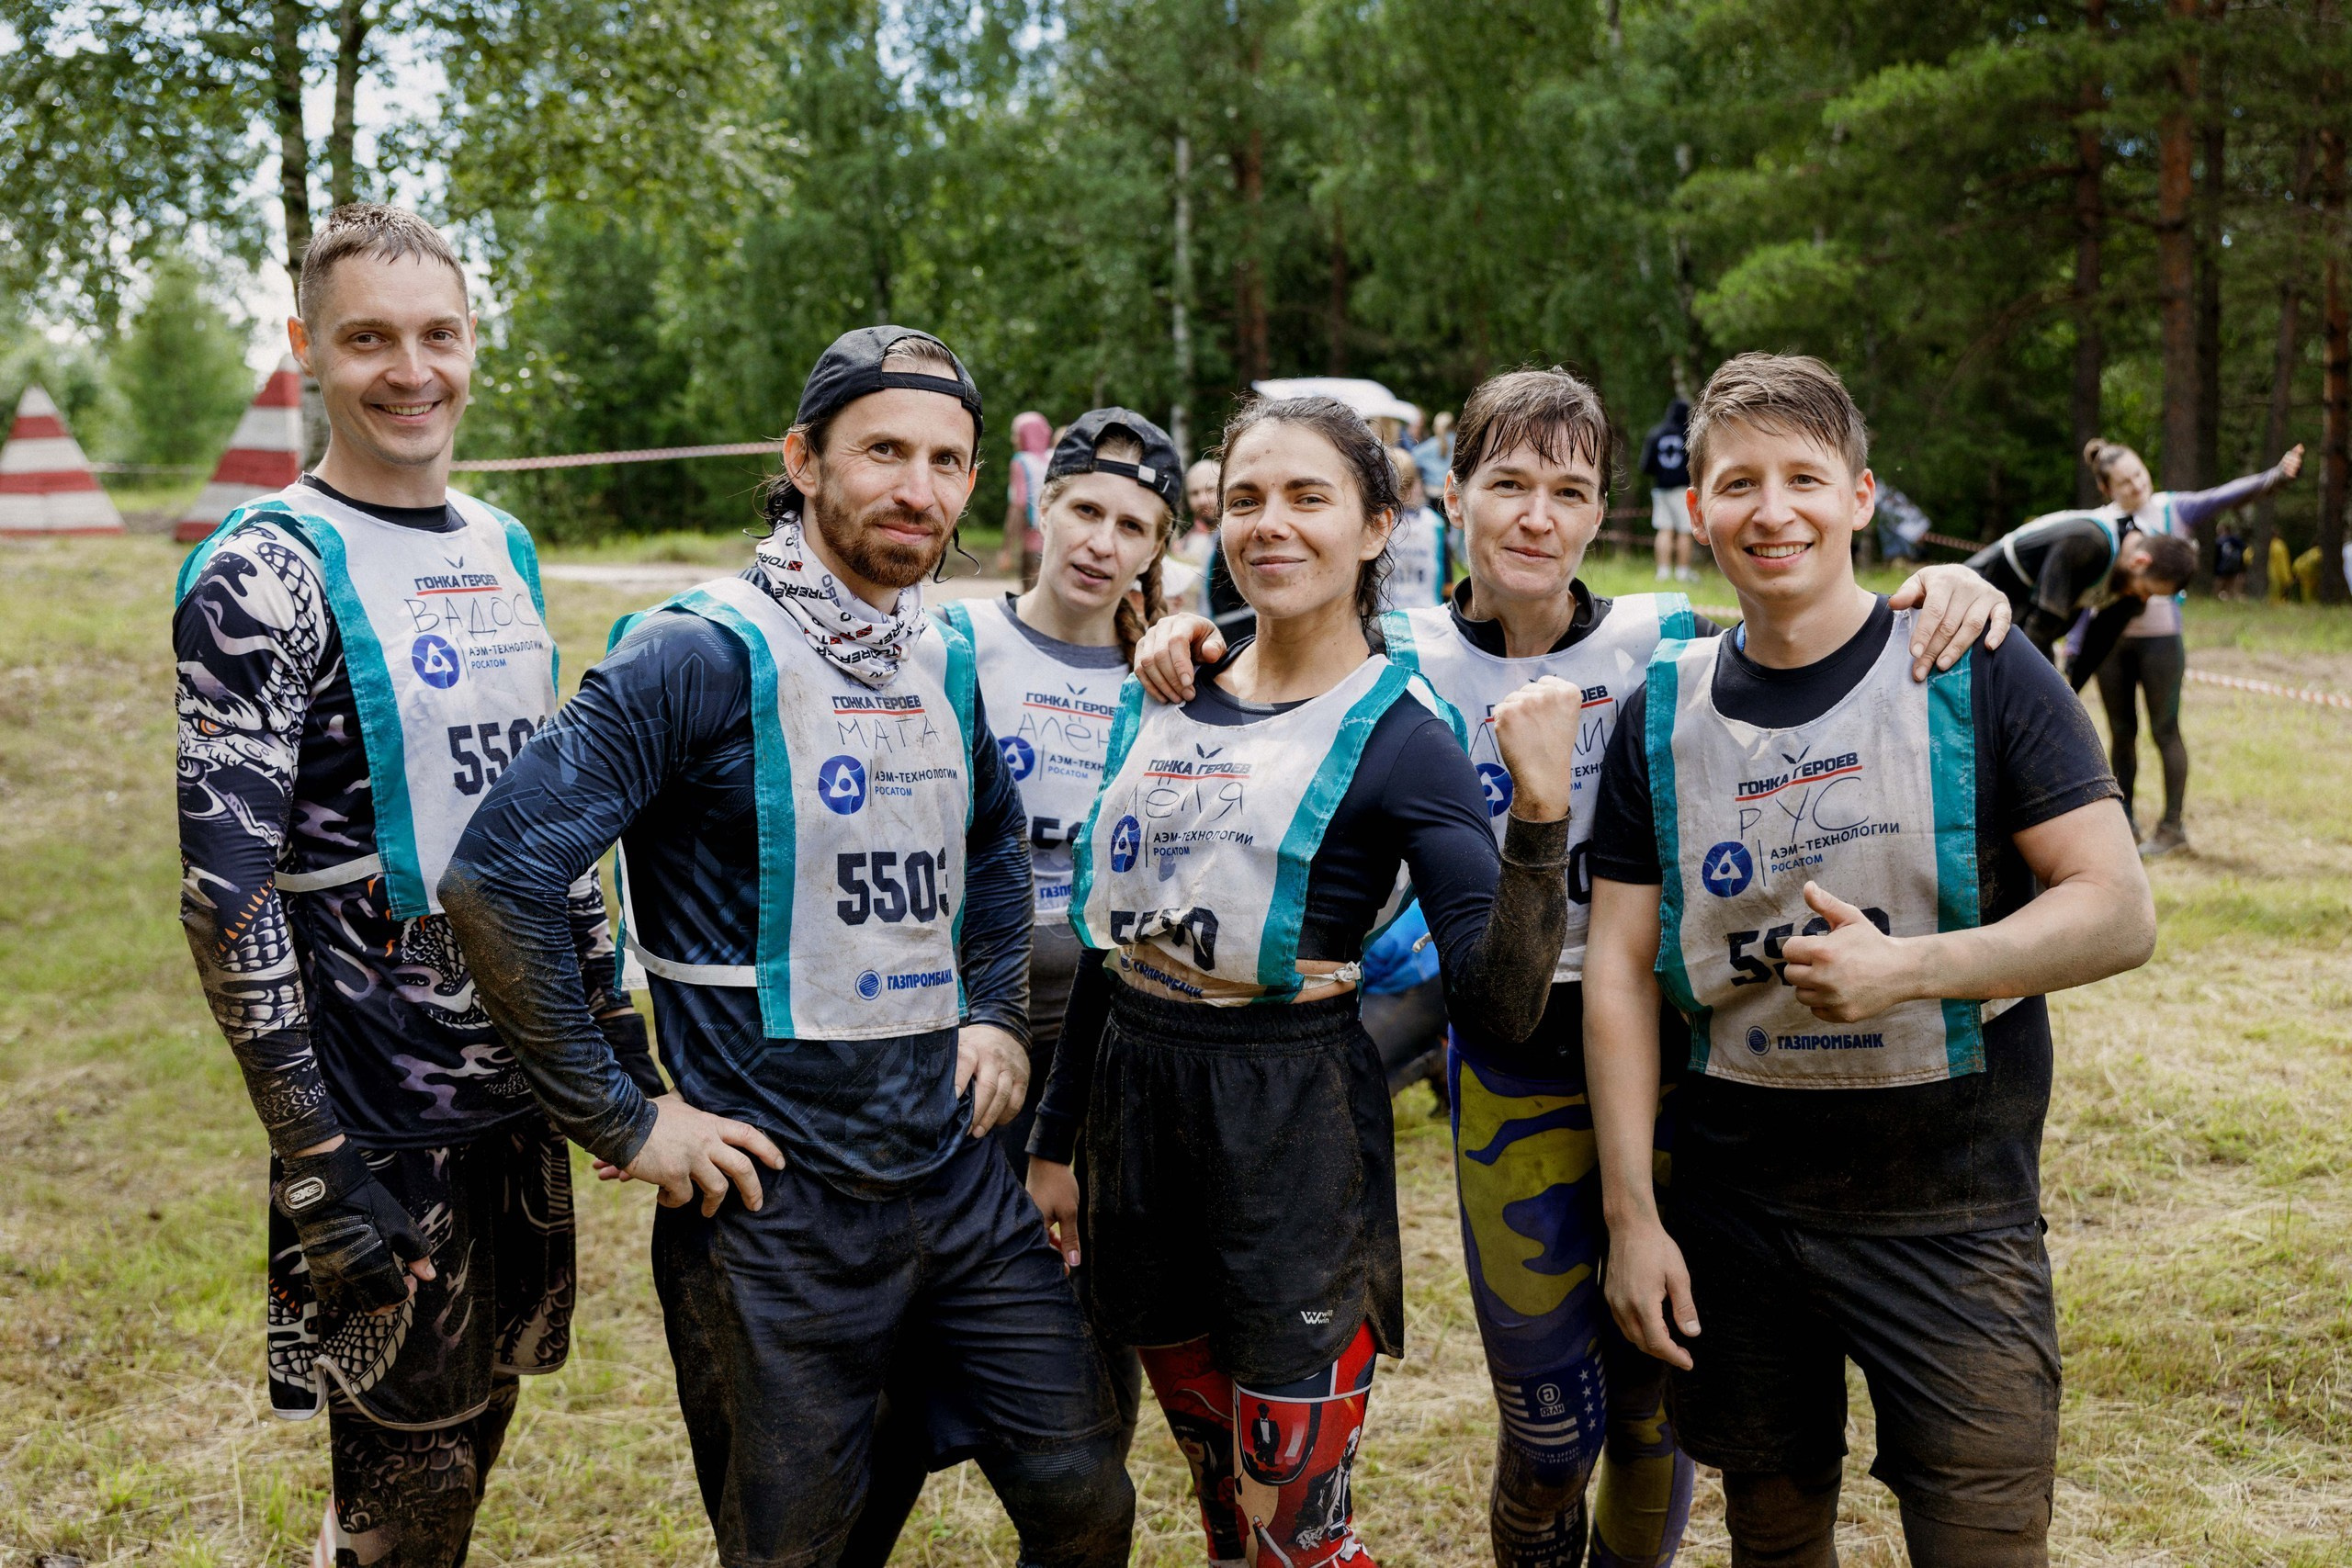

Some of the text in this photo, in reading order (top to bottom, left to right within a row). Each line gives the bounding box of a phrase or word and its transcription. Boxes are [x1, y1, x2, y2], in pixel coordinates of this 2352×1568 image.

[414, 574, 499, 591] ГОНКА ГЕРОЕВ
[404, 593, 539, 641] ВАДОС
[469, 640, 544, 657] АЭМ-ТЕХНОЛОГИИ
[470, 659, 507, 670] РОСАТОМ
[831, 694, 922, 710] ГОНКА ГЕРОЕВ
[1025, 692, 1115, 716] ГОНКА ГЕРОЕ
[447, 715, 547, 796] 550
[1049, 754, 1104, 773] АЭМ-ТЕХН
[875, 769, 957, 783] АЭМ-ТЕХНОЛОГИИ
[1048, 765, 1089, 779] РОСАТОМ
[1148, 759, 1252, 775] ГОНКА ГЕРОЕВ
[1737, 751, 1859, 796] ГОНКА ГЕРОЕВ
[875, 785, 912, 796] РОСАТОМ
[1739, 776, 1870, 844] РУС
[1153, 830, 1254, 847] АЭМ-ТЕХНОЛОГИИ
[1770, 822, 1901, 861] АЭМ-ТЕХНОЛОГИИ
[1153, 847, 1191, 857] РОСАТОМ
[1770, 853, 1824, 874] РОСАТОМ
[887, 970, 954, 991] ГАЗПРОМБАНК
[1777, 1032, 1884, 1051] ГАЗПРОМБАНК
